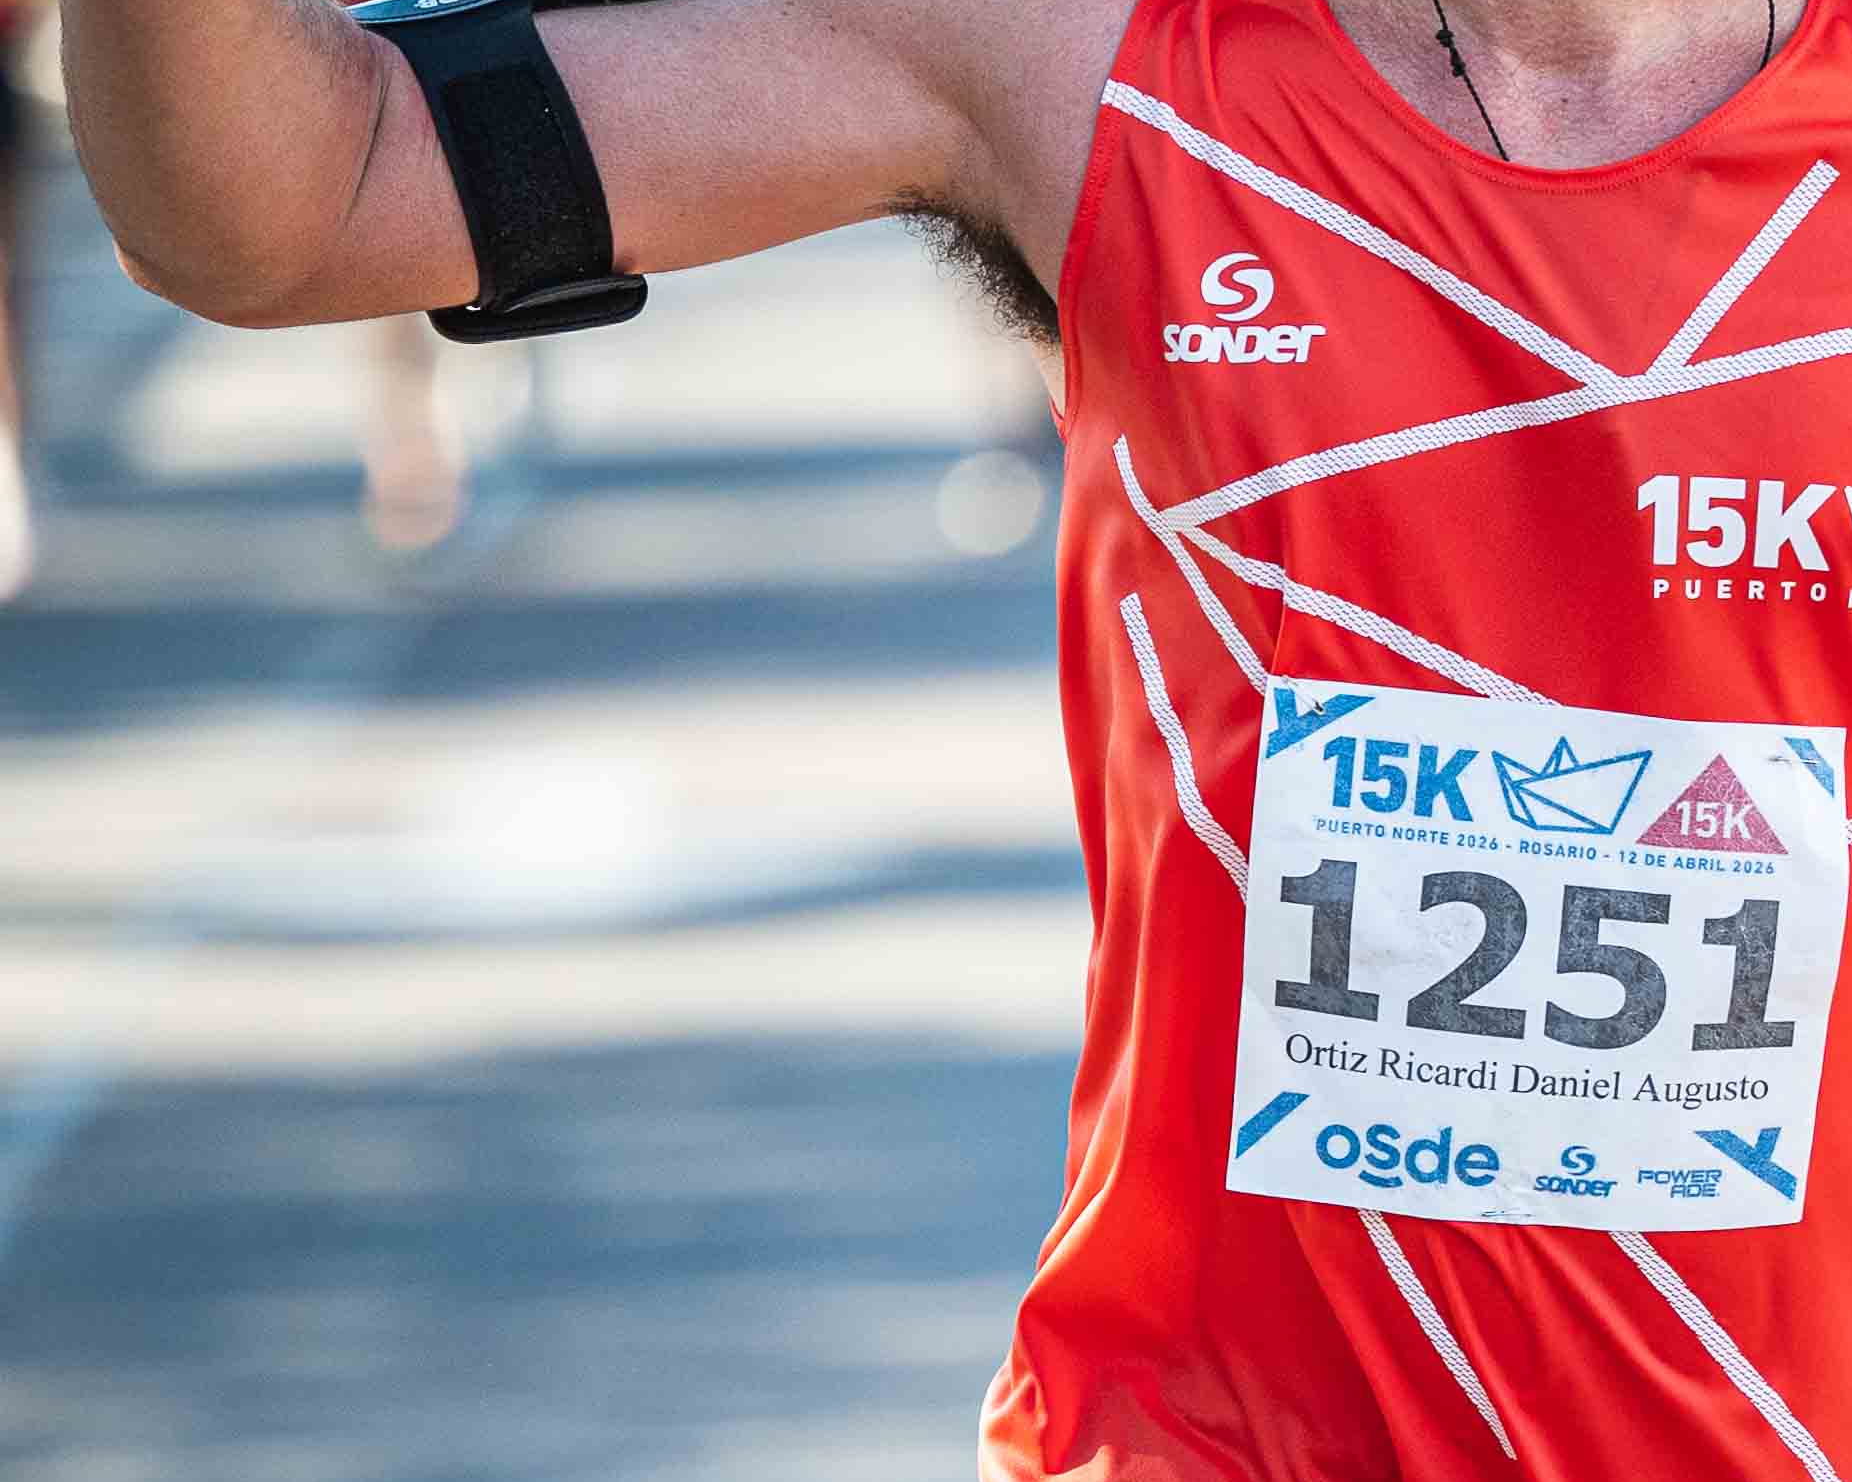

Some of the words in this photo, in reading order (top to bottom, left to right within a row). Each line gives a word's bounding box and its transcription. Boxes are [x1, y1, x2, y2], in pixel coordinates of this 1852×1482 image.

[1637, 474, 1838, 572] 15K
[1652, 579, 1827, 602] PUERTO
[1321, 735, 1480, 825] 15K
[1315, 818, 1385, 838] PUERTO
[1392, 826, 1450, 846] NORTE
[1455, 833, 1499, 851] 2026
[1519, 840, 1597, 861] ROSARIO
[1618, 850, 1638, 865] 12
[1644, 853, 1666, 868] DE
[1673, 856, 1725, 872] ABRIL
[1732, 859, 1776, 875] 2026
[1675, 800, 1755, 843] 15K
[1273, 858, 1796, 1053] 1251
[1285, 1033, 1369, 1074] Ortiz
[1378, 1047, 1497, 1091] Ricardi
[1510, 1063, 1621, 1100] Daniel
[1633, 1072, 1769, 1111] Augusto
[1315, 1123, 1500, 1188] osde
[1636, 1167, 1723, 1185] POWER
